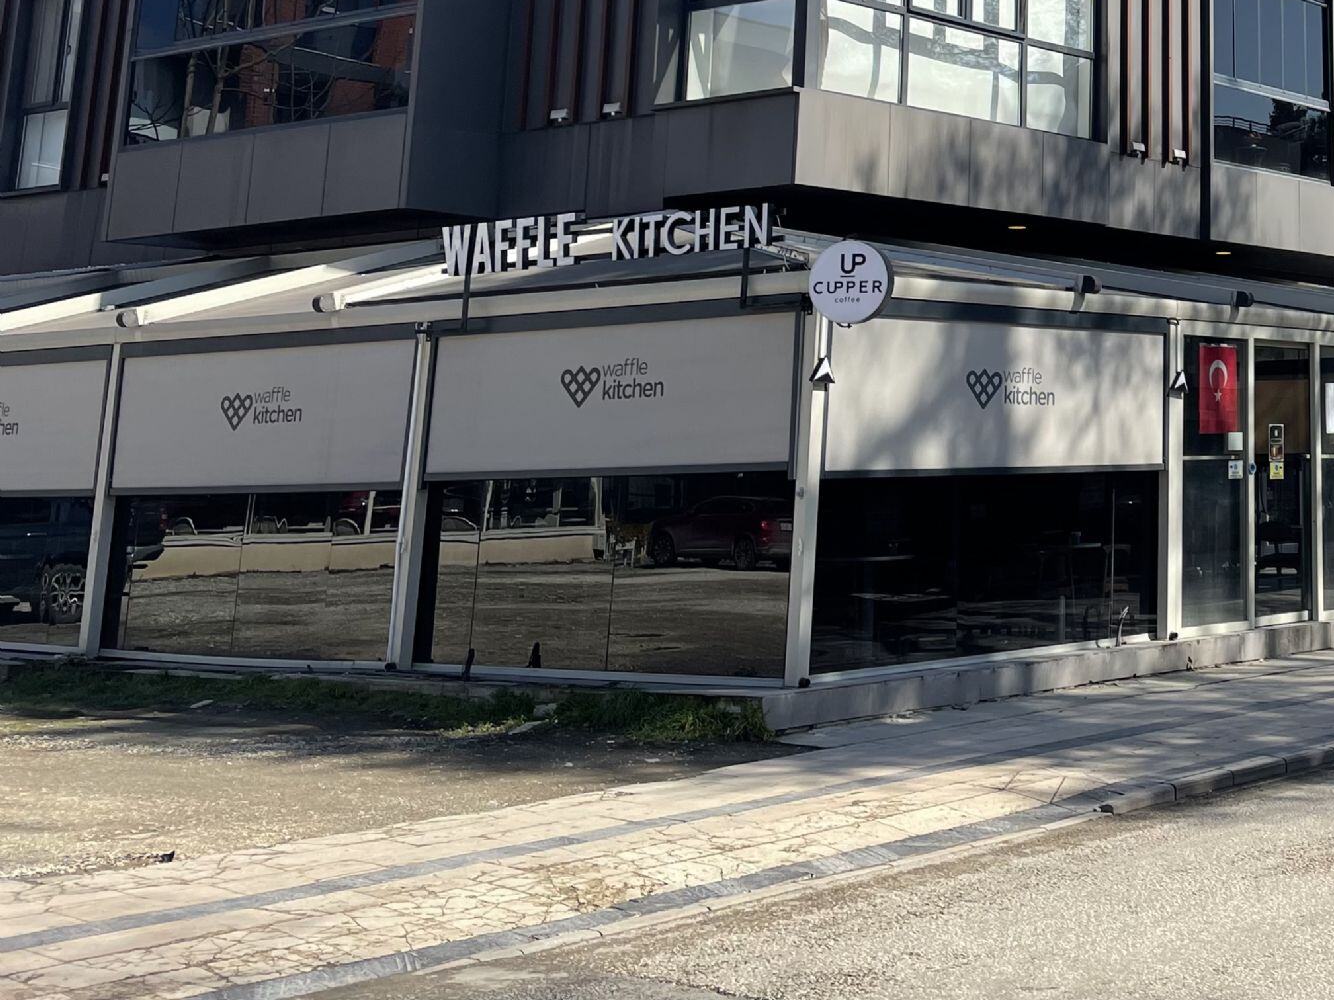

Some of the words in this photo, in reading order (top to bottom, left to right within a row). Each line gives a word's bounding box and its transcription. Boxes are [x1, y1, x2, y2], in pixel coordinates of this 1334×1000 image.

[442, 211, 578, 277] WAFFLE
[611, 202, 770, 262] KITCHEN
[841, 253, 866, 275] UP
[813, 280, 883, 295] CUPPER
[834, 296, 861, 304] coffee
[602, 357, 648, 377] waffle
[1003, 367, 1043, 385] waffle
[253, 386, 292, 404] waffle
[602, 377, 664, 401] kitchen
[1004, 385, 1055, 406] kitchen
[252, 404, 302, 425] kitchen
